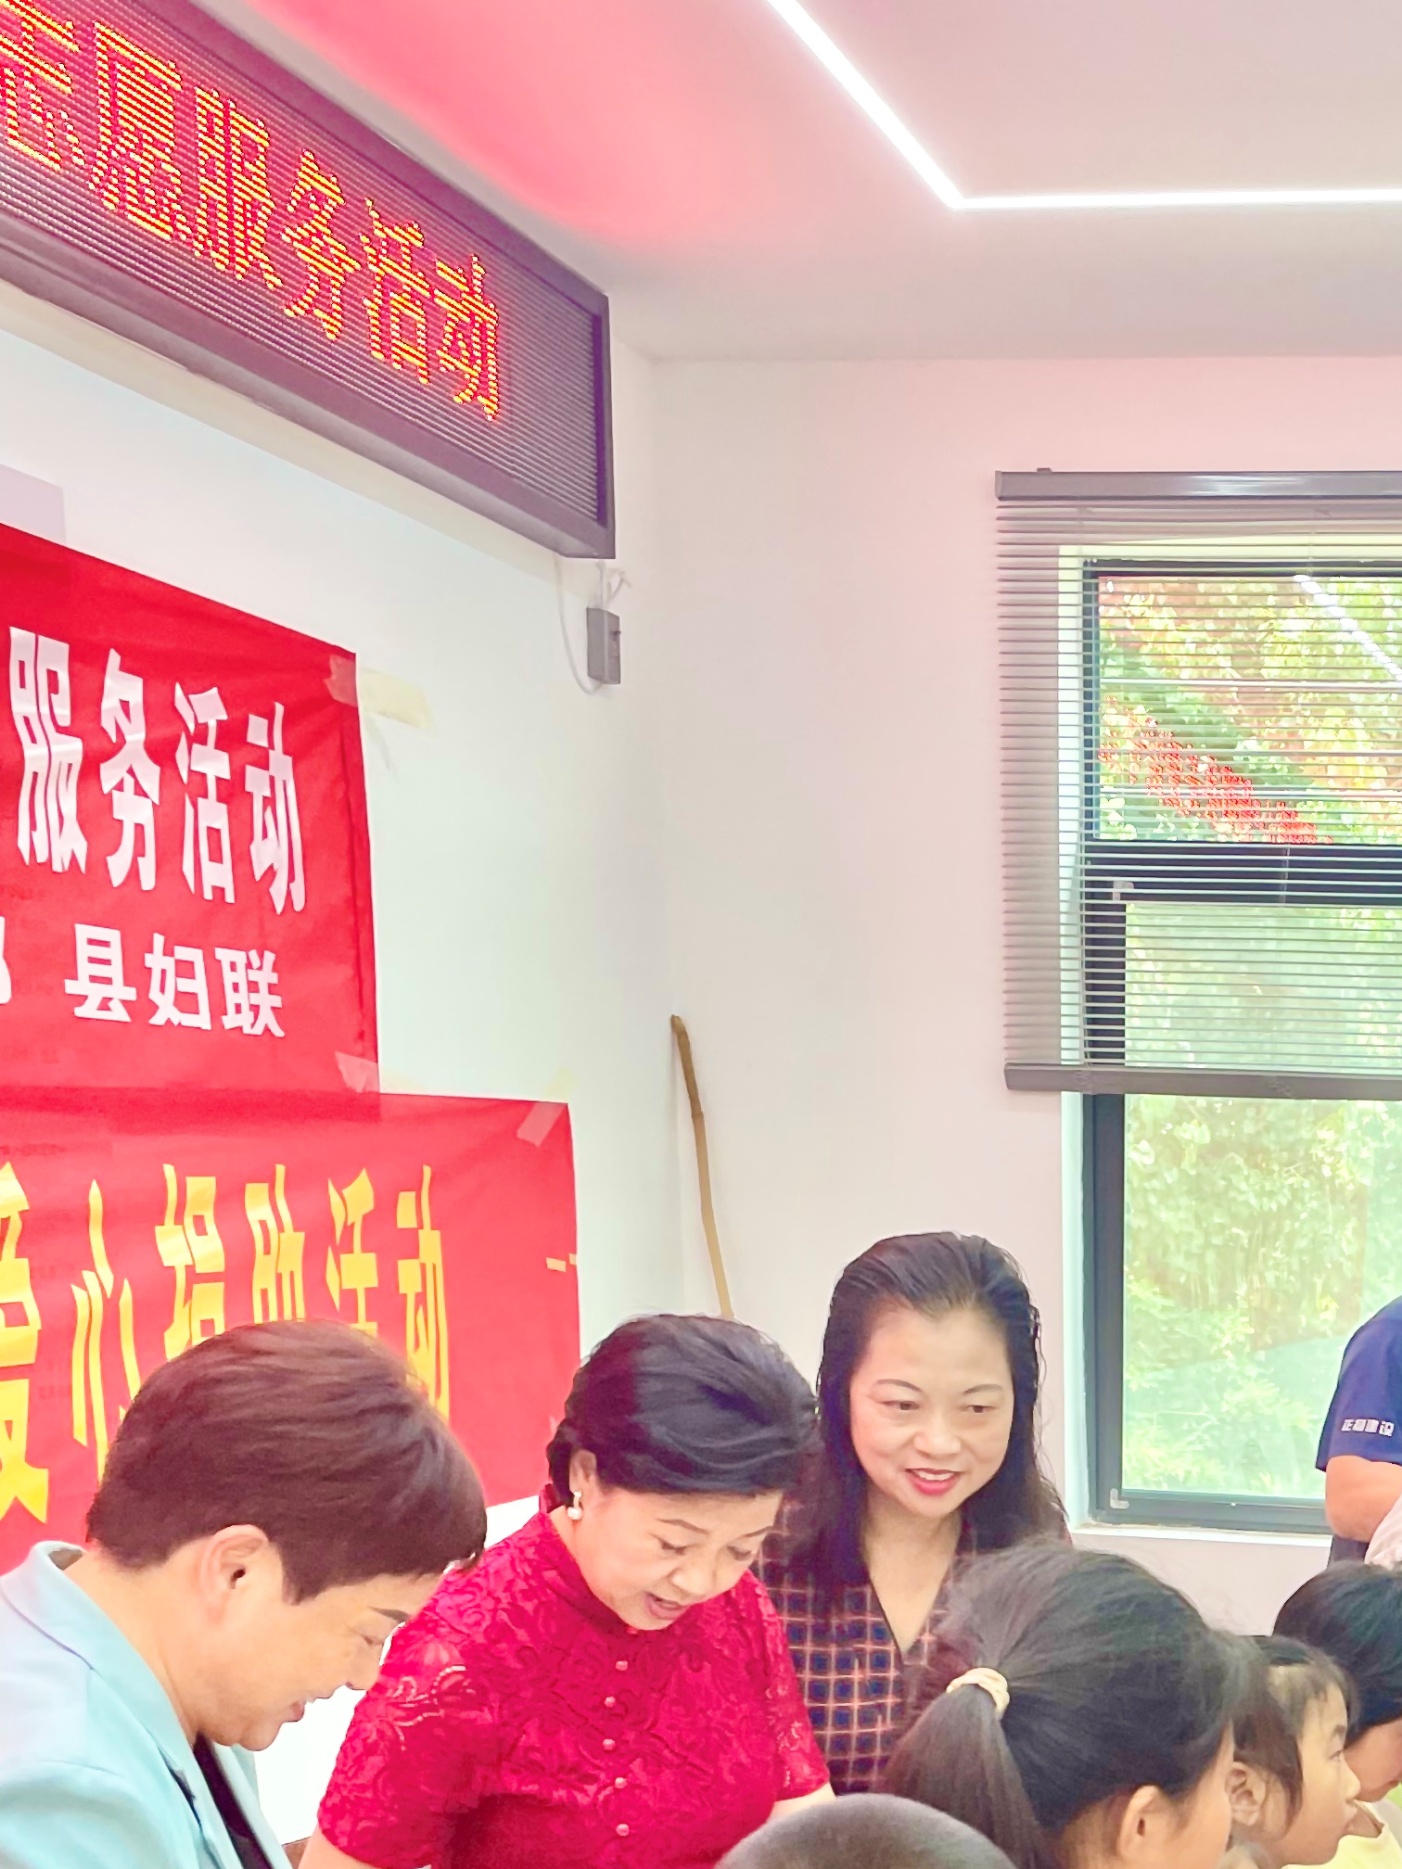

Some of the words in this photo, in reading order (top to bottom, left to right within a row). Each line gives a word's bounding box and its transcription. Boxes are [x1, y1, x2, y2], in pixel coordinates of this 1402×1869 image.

[8, 625, 306, 915] 服务活动
[65, 922, 286, 1038] 县妇联
